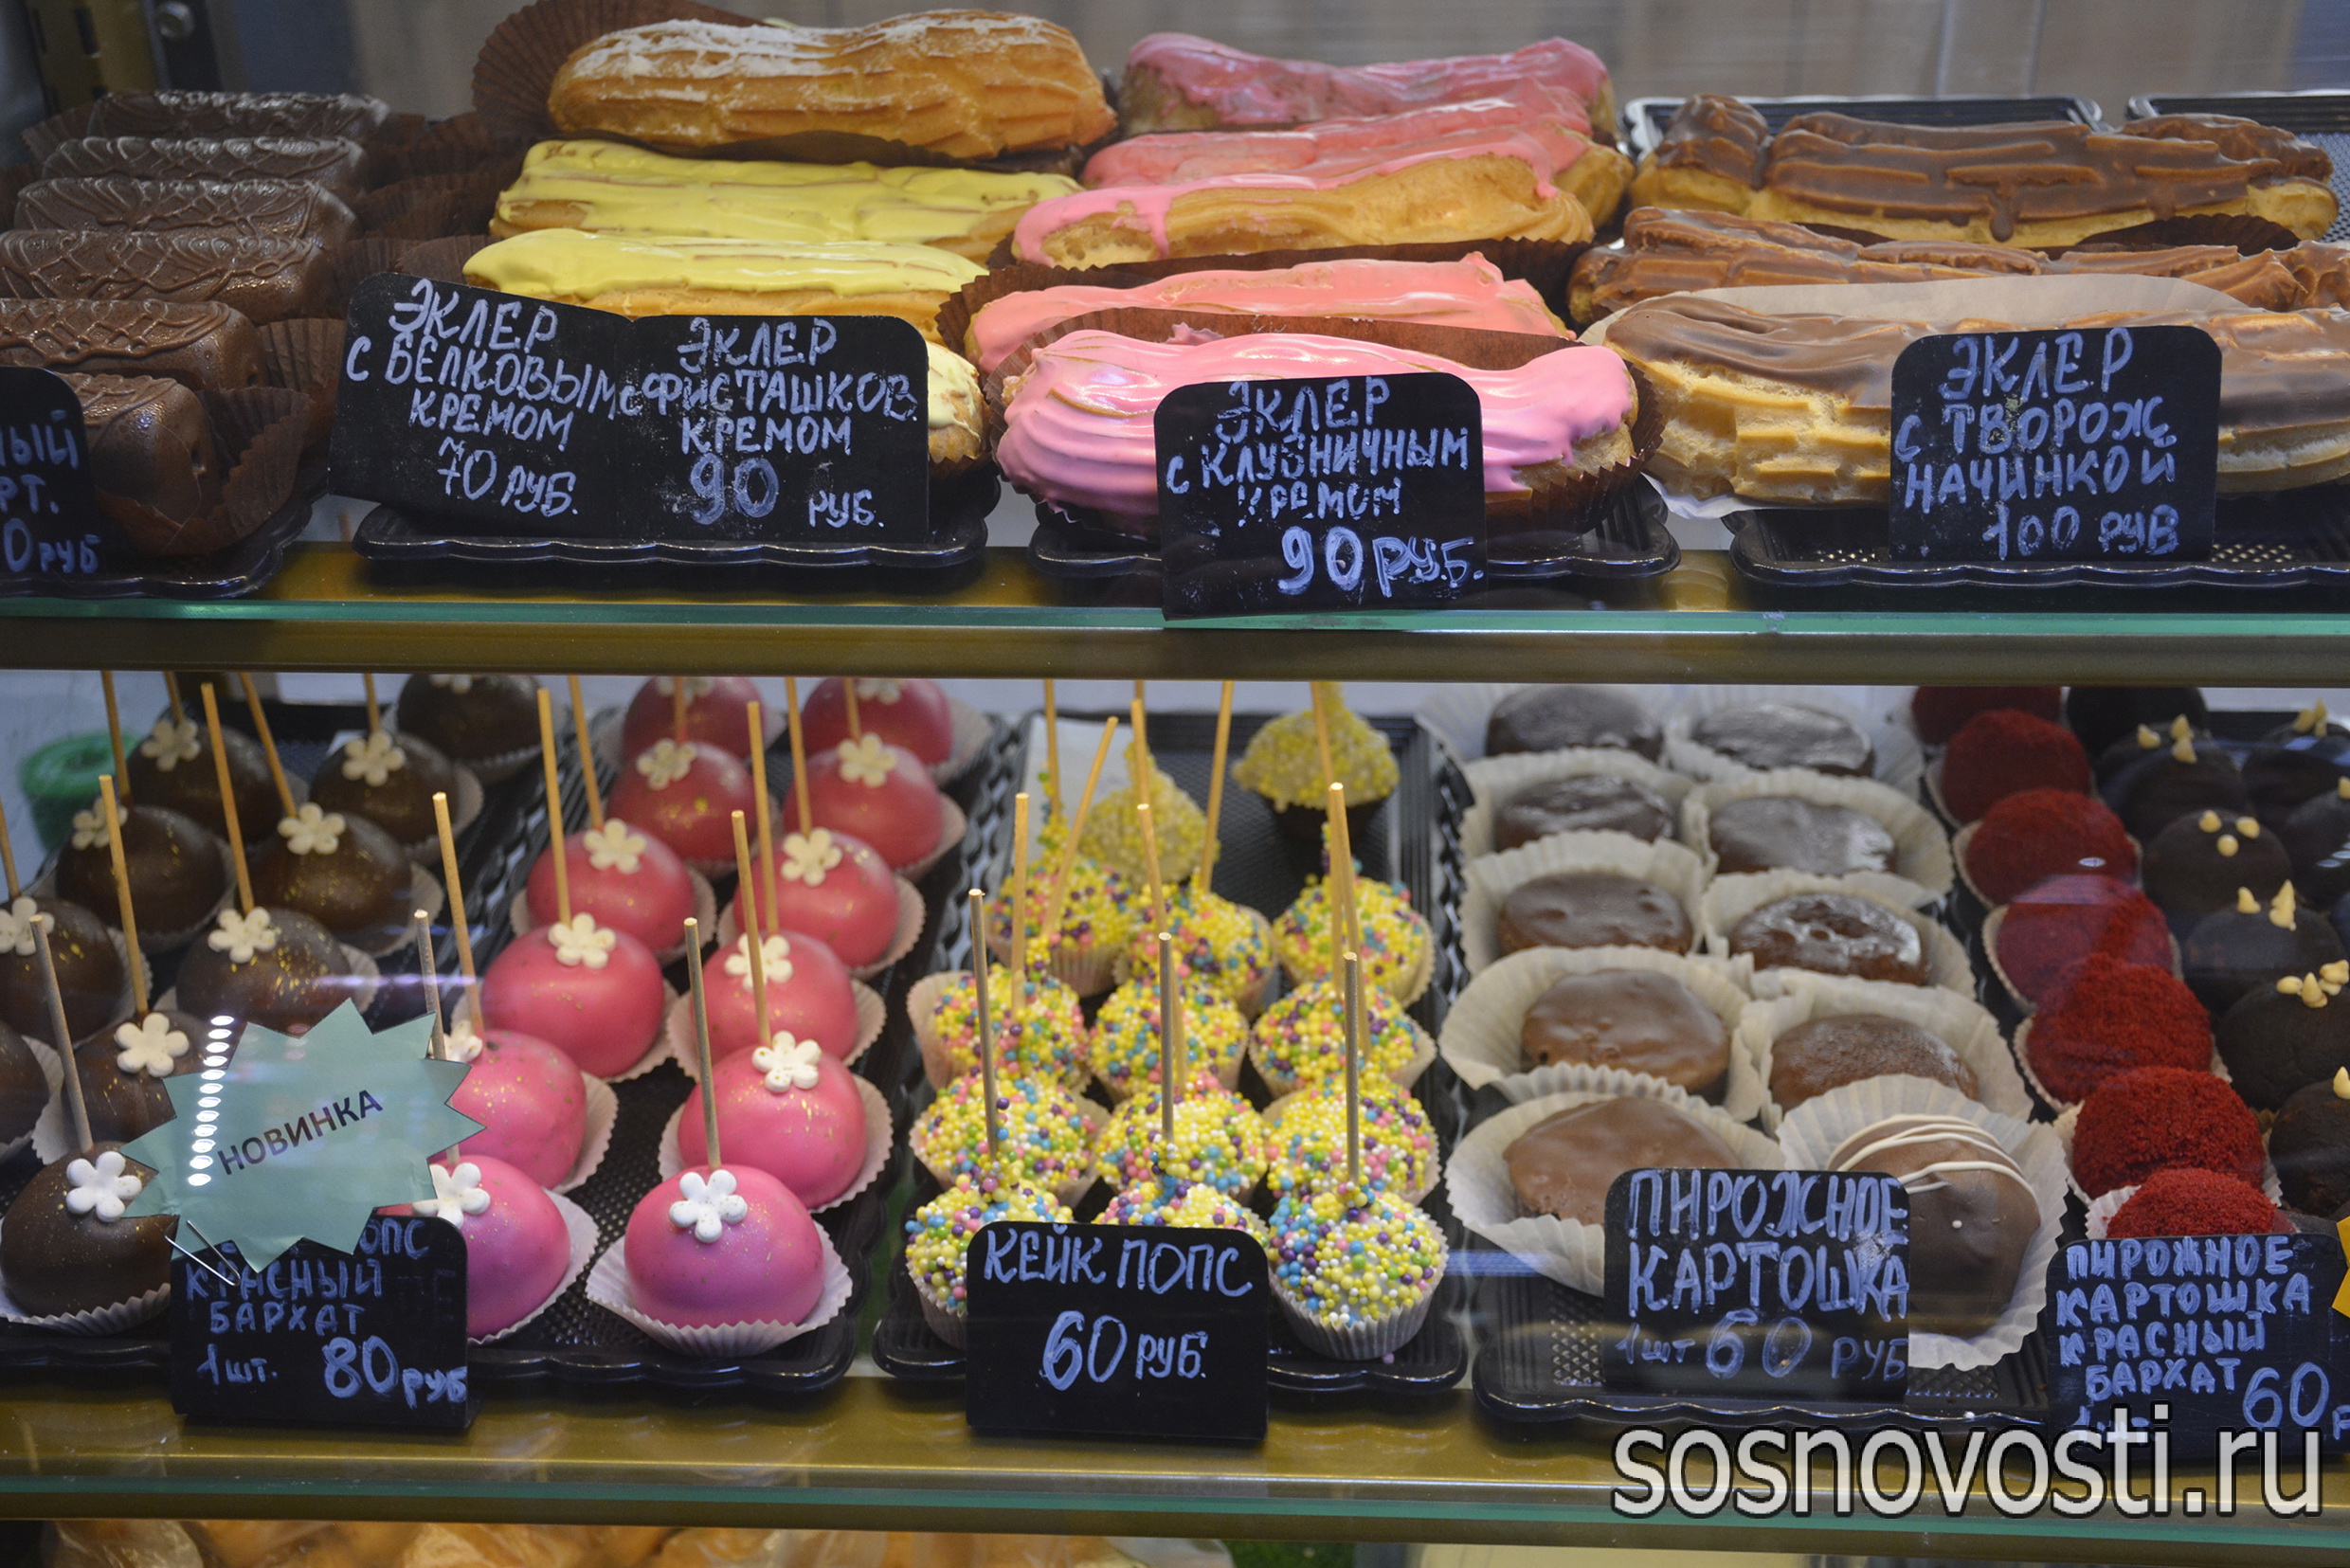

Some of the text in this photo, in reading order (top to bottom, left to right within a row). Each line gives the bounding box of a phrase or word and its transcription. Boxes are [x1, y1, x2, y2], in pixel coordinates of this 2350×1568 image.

[389, 279, 558, 353] ЭКЛЕР
[677, 317, 837, 373] ЭКЛЕР
[385, 331, 616, 420] БЕЛКОВЫМ
[1938, 327, 2134, 402] ЭКЛЕР
[0, 409, 79, 469] ЫЙ
[408, 388, 573, 452] КРЕМОМ
[681, 416, 851, 456] КРЕМОМ
[1215, 376, 1390, 443] ЭКЛЕР
[438, 437, 497, 500] 70
[690, 453, 779, 525] 90
[1202, 426, 1468, 488] КЛУБНИЧНЫМ
[1278, 525, 1365, 595] 90
[1981, 501, 2081, 561] 100
[217, 1090, 384, 1175] НОВИНКА
[359, 1217, 428, 1259] ОПС
[1628, 1169, 1909, 1246] ПИРОЖНОЕ
[186, 1258, 382, 1301] КРАСНЫЙ
[984, 1223, 1253, 1297] КЕЙК ПОПС
[1629, 1241, 1909, 1322] КАРТОШКА
[2067, 1235, 2293, 1280] ПИРОЖНОЕ
[209, 1301, 366, 1336] БАРХАТ
[2056, 1272, 2309, 1326] КАРТОШКА
[1042, 1310, 1128, 1391] 60
[1706, 1308, 1812, 1379] 60
[2059, 1310, 2266, 1367] КРАСНЫЙ
[2086, 1358, 2241, 1402] БАРХАТ
[2242, 1361, 2329, 1431] 60
